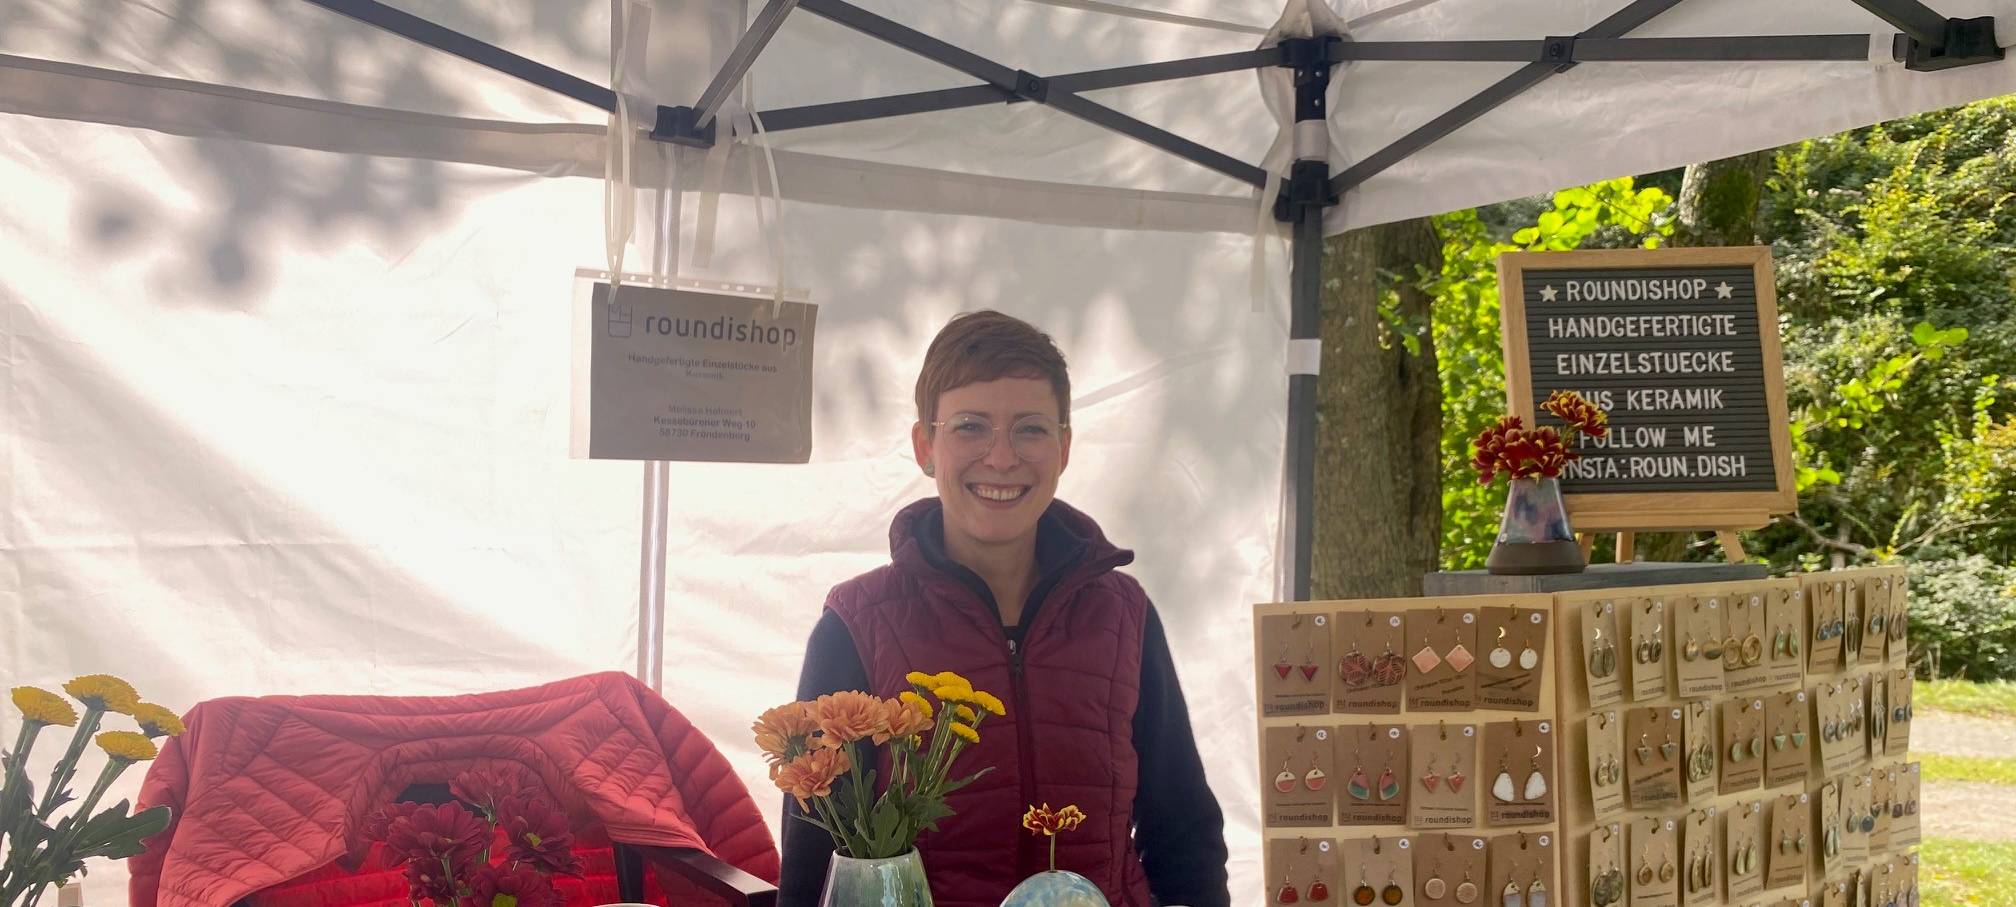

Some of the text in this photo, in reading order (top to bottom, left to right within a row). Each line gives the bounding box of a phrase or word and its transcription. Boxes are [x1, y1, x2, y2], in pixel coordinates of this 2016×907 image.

[1566, 279, 1707, 301] ROUNDISHOP
[645, 315, 797, 352] roundishop
[1549, 315, 1737, 338] HANDGEFERTIGTE
[1557, 351, 1735, 375] EINZELSTUECKE
[1627, 388, 1724, 411] KERAMIK
[1579, 426, 1716, 449] FOLLOW ME
[1483, 696, 1534, 708] roundishop
[1279, 812, 1329, 823] roundishop
[1352, 812, 1403, 823] roundishop
[1423, 814, 1472, 825] roundishop
[1500, 809, 1550, 820] roundishop
